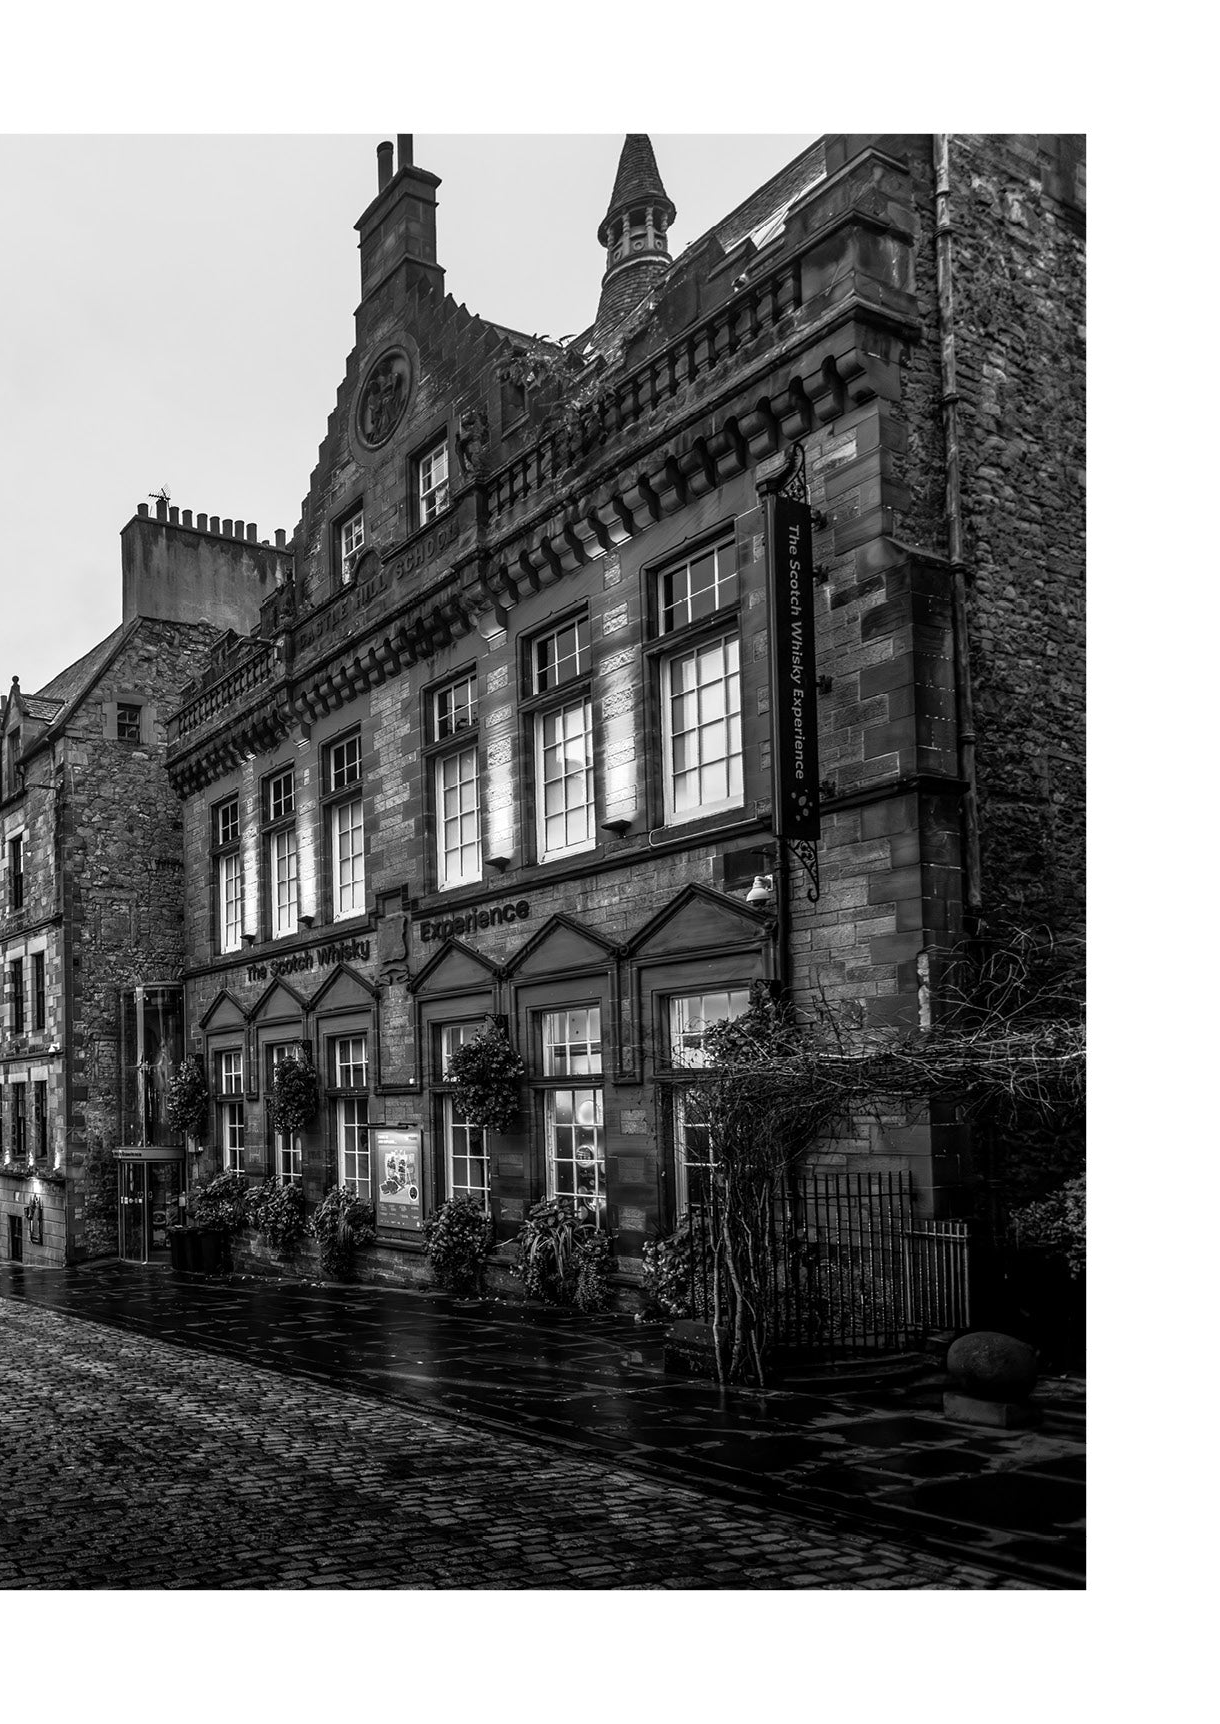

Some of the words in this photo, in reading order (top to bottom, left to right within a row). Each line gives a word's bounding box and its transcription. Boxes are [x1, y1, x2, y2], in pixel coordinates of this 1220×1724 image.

[355, 576, 388, 611] HILL
[394, 522, 460, 581] SCHOOL
[788, 524, 801, 556] The
[789, 559, 802, 616] Scotch
[790, 621, 804, 685] Whisky
[791, 688, 806, 780] Experience
[420, 900, 531, 943] Experience
[246, 963, 268, 982] The
[269, 950, 314, 977] Scotch
[316, 938, 370, 962] Whisky
